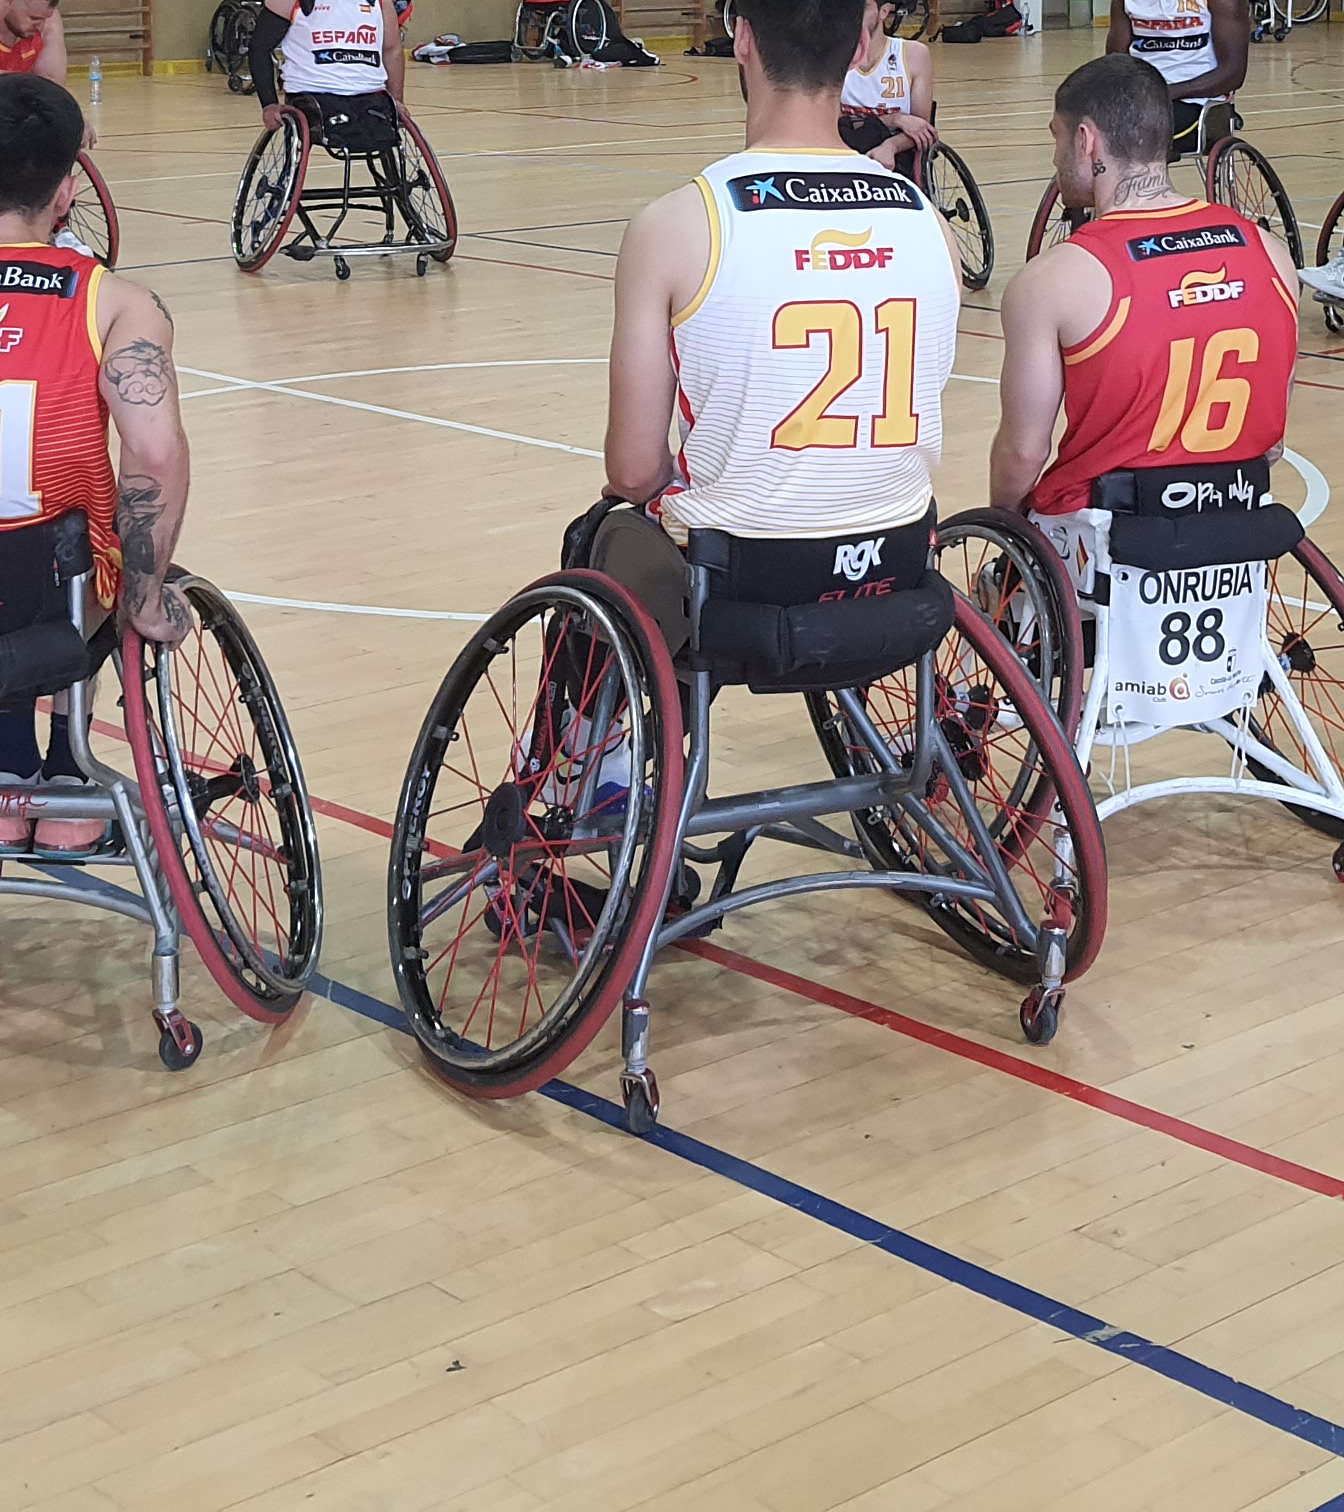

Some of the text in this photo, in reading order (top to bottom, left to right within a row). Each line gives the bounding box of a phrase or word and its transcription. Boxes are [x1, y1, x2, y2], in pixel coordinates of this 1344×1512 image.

[311, 24, 377, 45] ESPAÑA
[880, 76, 905, 98] 21
[785, 178, 913, 203] CaixaBank
[794, 238, 894, 271] FEDDF
[1161, 229, 1239, 251] CaixaBank
[1168, 273, 1245, 308] FEDDF
[770, 297, 919, 451] 21
[1147, 327, 1260, 453] 16
[1138, 563, 1253, 605] ONRUBIA
[1158, 607, 1225, 666] 88
[1115, 680, 1167, 696] amiab
